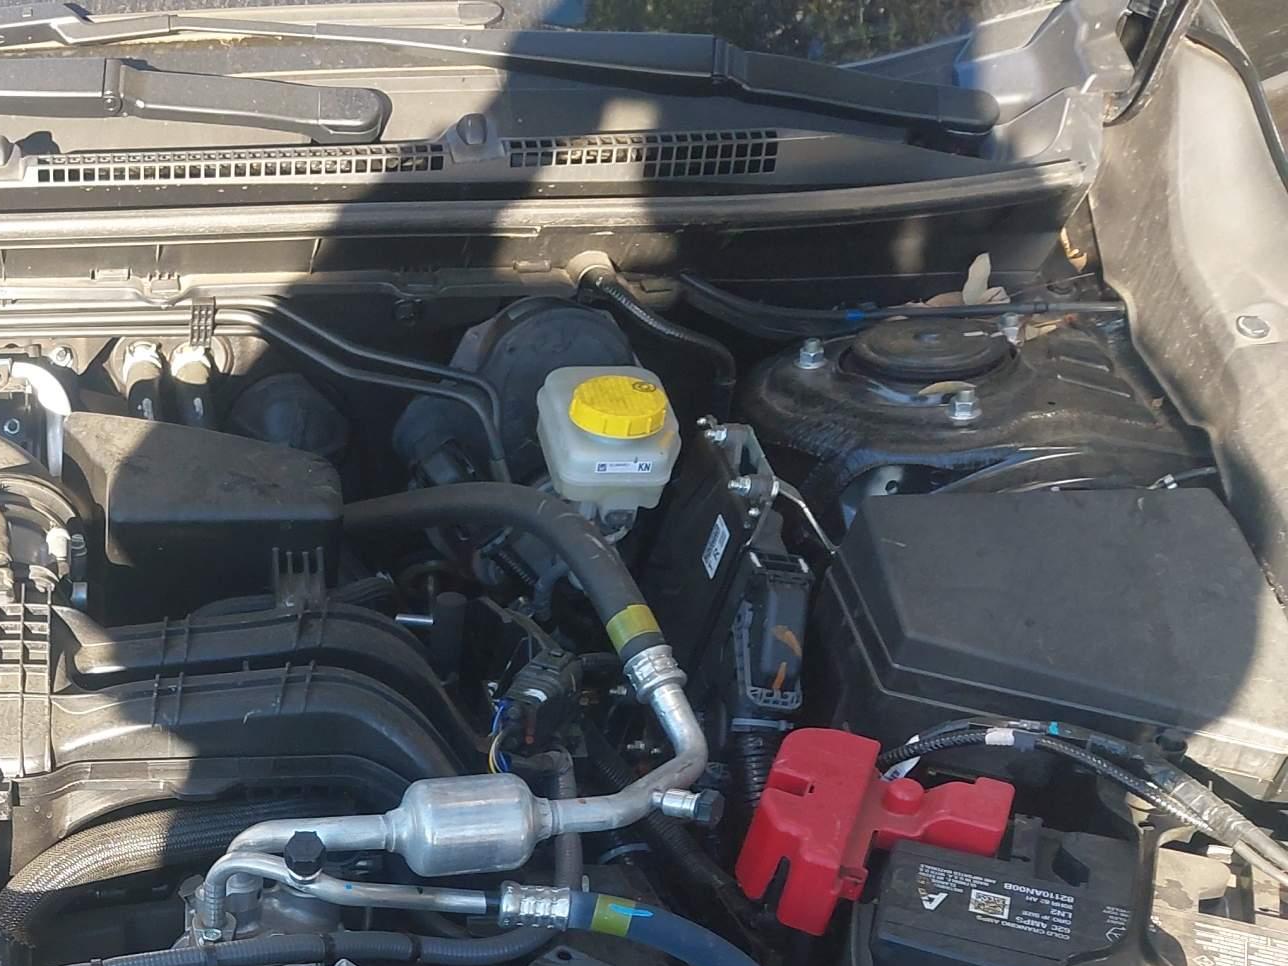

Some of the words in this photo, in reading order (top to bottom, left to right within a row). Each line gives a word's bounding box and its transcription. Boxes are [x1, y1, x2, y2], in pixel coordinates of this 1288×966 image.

[638, 462, 651, 472] KN
[1003, 882, 1074, 903] 82110AN00B
[1050, 908, 1072, 919] LN2
[1000, 920, 1046, 935] CRANKING
[1015, 916, 1047, 929] AMPS
[1046, 930, 1070, 940] COLD
